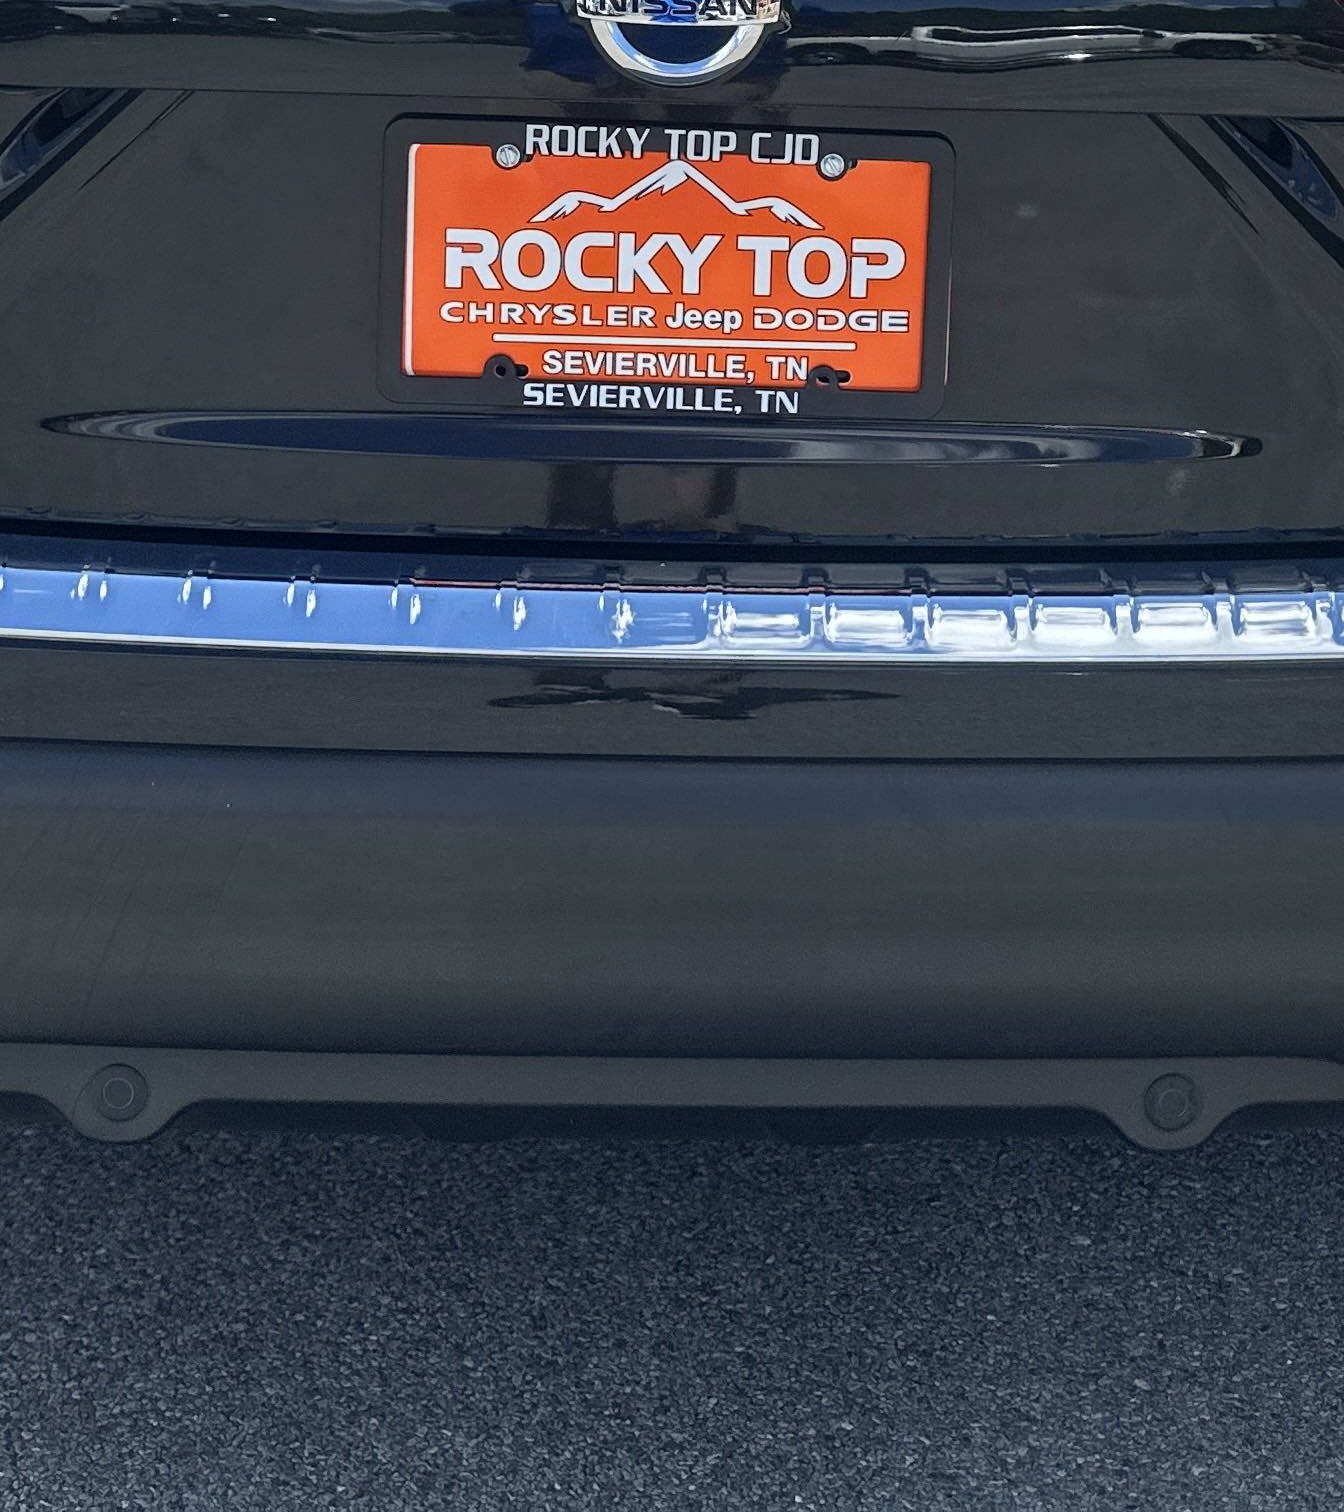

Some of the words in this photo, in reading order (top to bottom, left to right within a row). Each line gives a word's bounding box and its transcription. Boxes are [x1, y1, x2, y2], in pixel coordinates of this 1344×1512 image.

[525, 124, 650, 159] ROCKY
[664, 129, 737, 162] TOP
[750, 132, 819, 165] CJD
[445, 229, 723, 295] ROCKY
[737, 236, 906, 299] TOP
[440, 301, 656, 327] CHRYSLER
[666, 303, 742, 334] Jeep
[754, 308, 910, 332] DODGE
[542, 350, 755, 384] SEVIERVILLE,
[765, 355, 808, 380] TN
[523, 382, 742, 415] SEVIERVILLE,
[755, 390, 800, 414] TN
